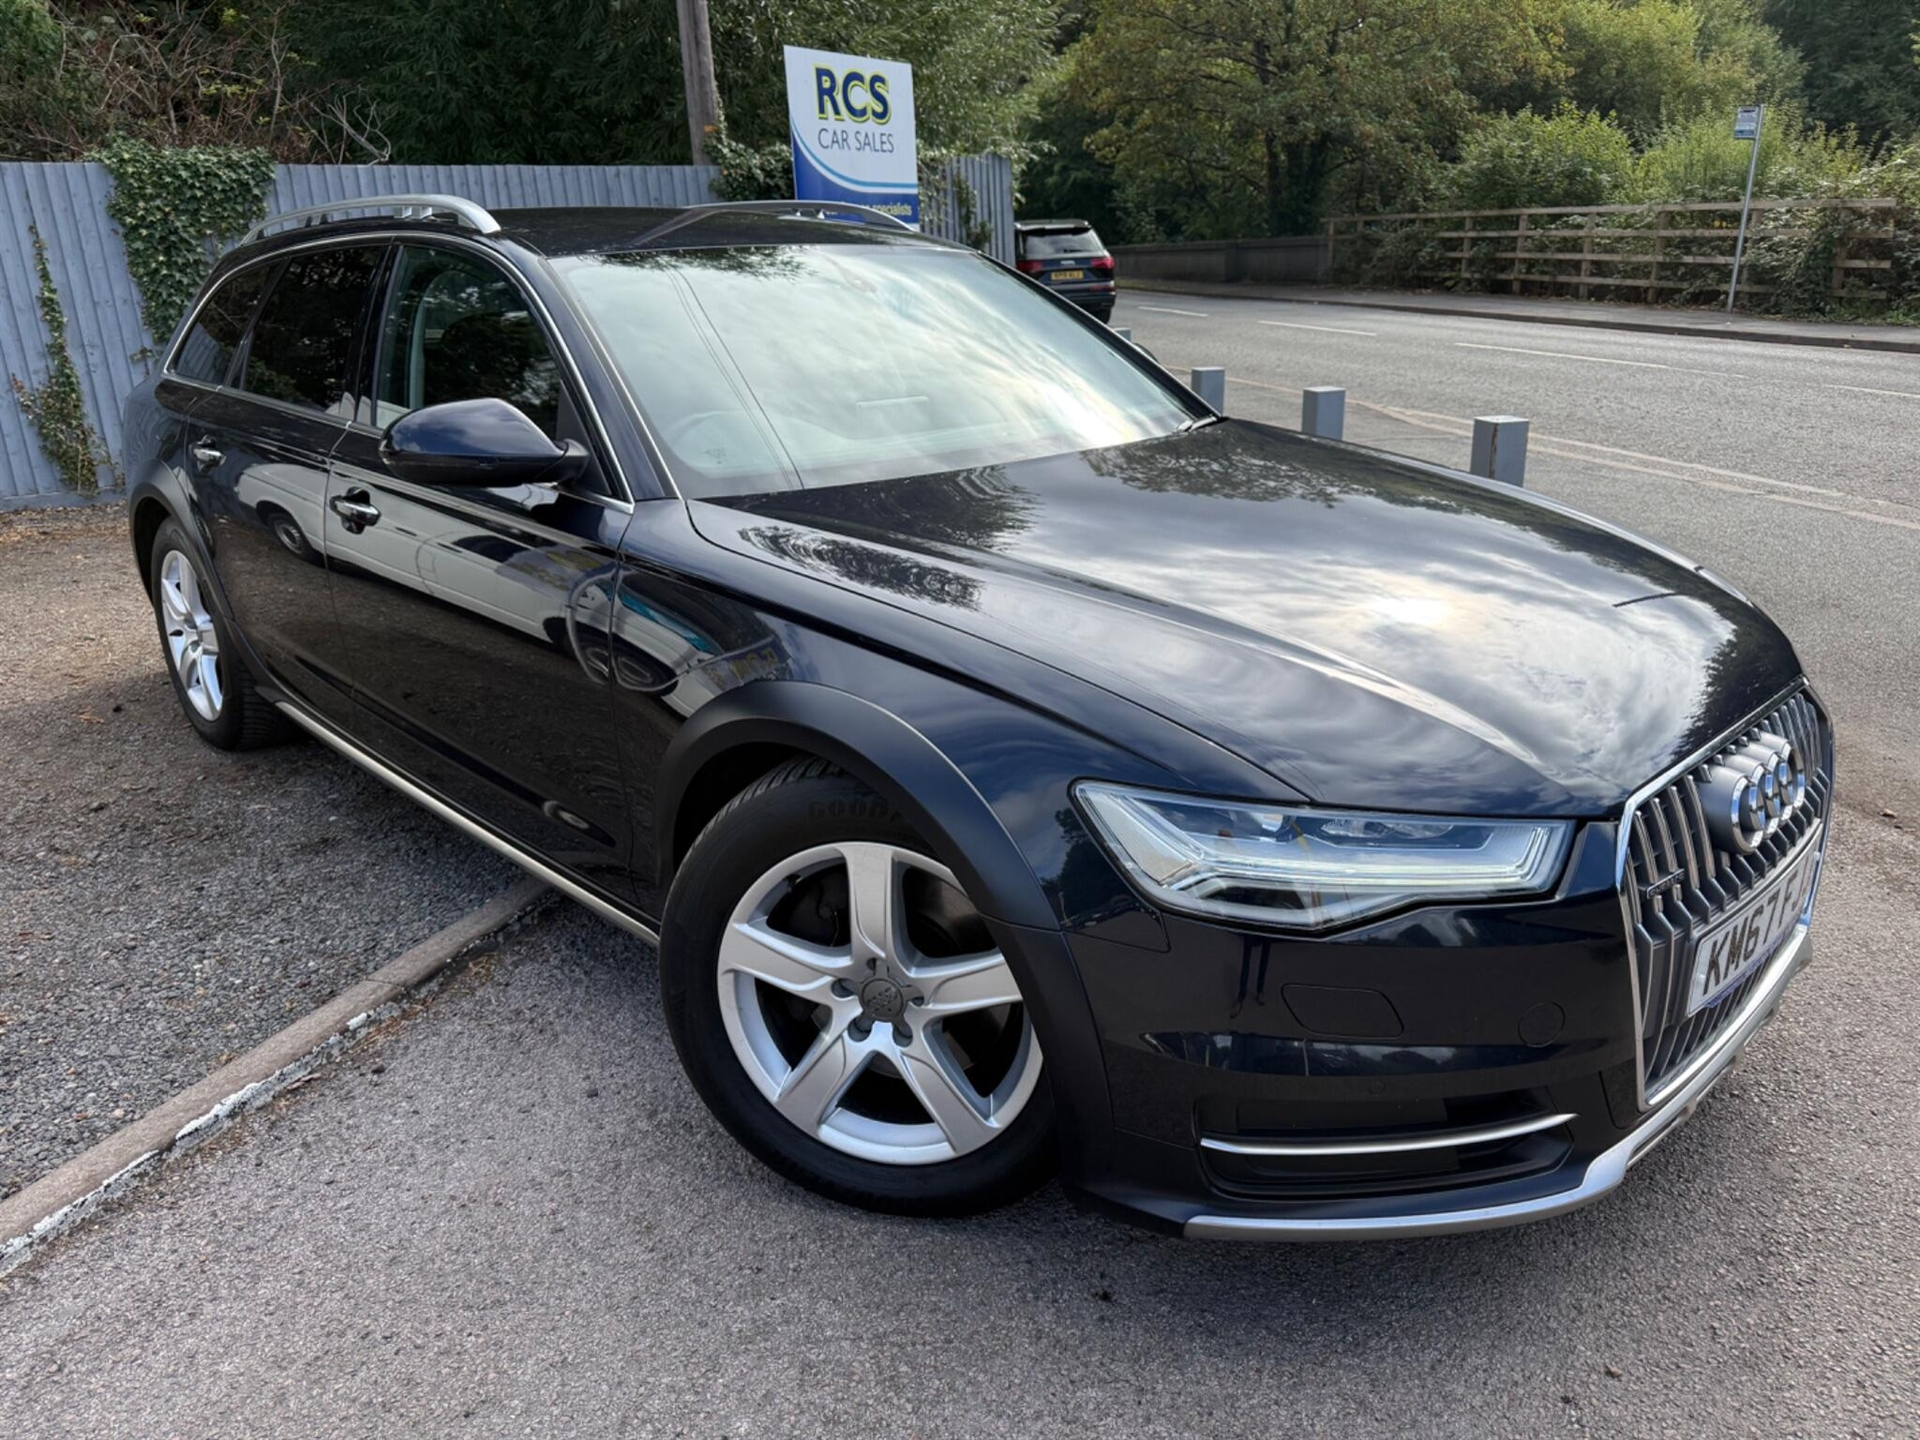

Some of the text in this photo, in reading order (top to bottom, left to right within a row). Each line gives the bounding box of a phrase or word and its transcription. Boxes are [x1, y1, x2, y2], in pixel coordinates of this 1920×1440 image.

[814, 64, 891, 124] RCS
[817, 127, 894, 153] CAR SALES
